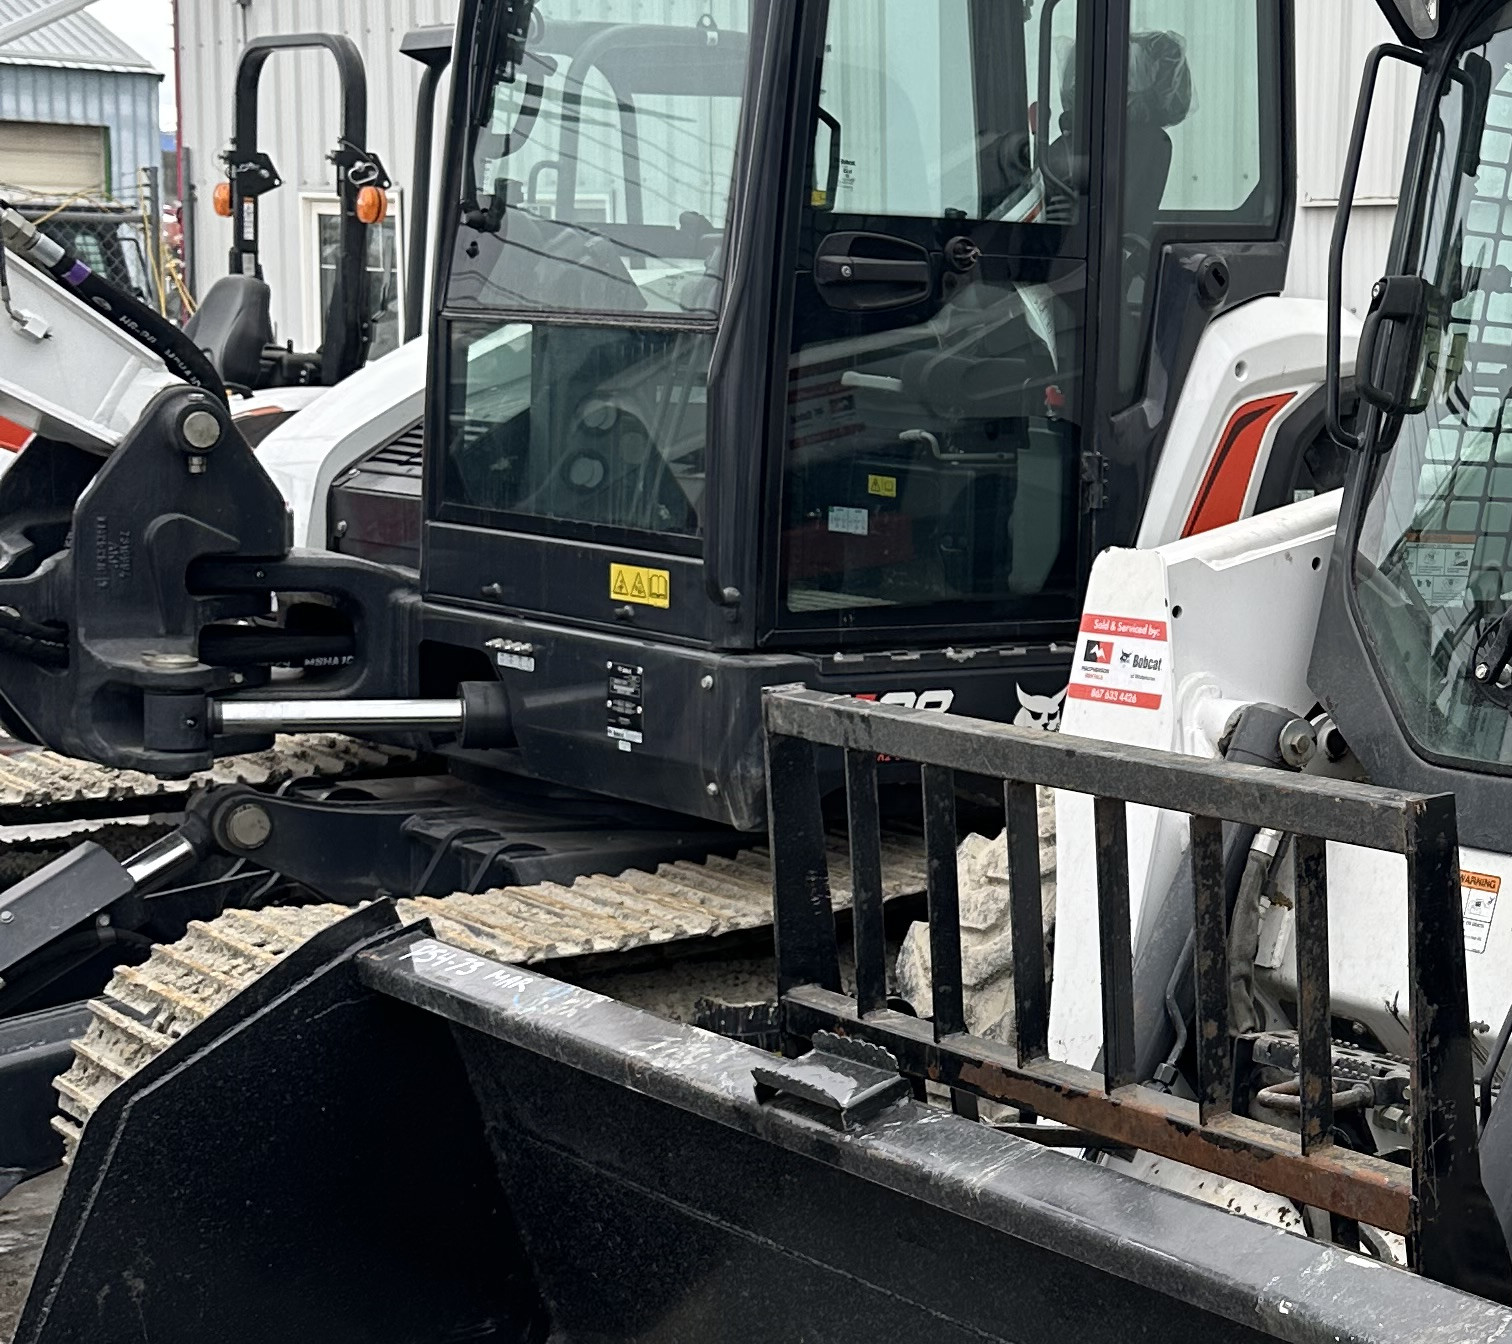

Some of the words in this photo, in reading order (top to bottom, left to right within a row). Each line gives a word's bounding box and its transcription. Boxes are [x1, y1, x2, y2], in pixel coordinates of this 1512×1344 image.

[1093, 618, 1110, 631] Sold
[1110, 621, 1116, 631] &
[1117, 622, 1148, 635] Serviced
[1148, 624, 1161, 638] by:
[1132, 654, 1162, 671] Bobcat
[1090, 688, 1105, 698] 867
[1104, 690, 1118, 701] 633
[1119, 692, 1137, 703] 4426
[484, 969, 534, 993] MAR
